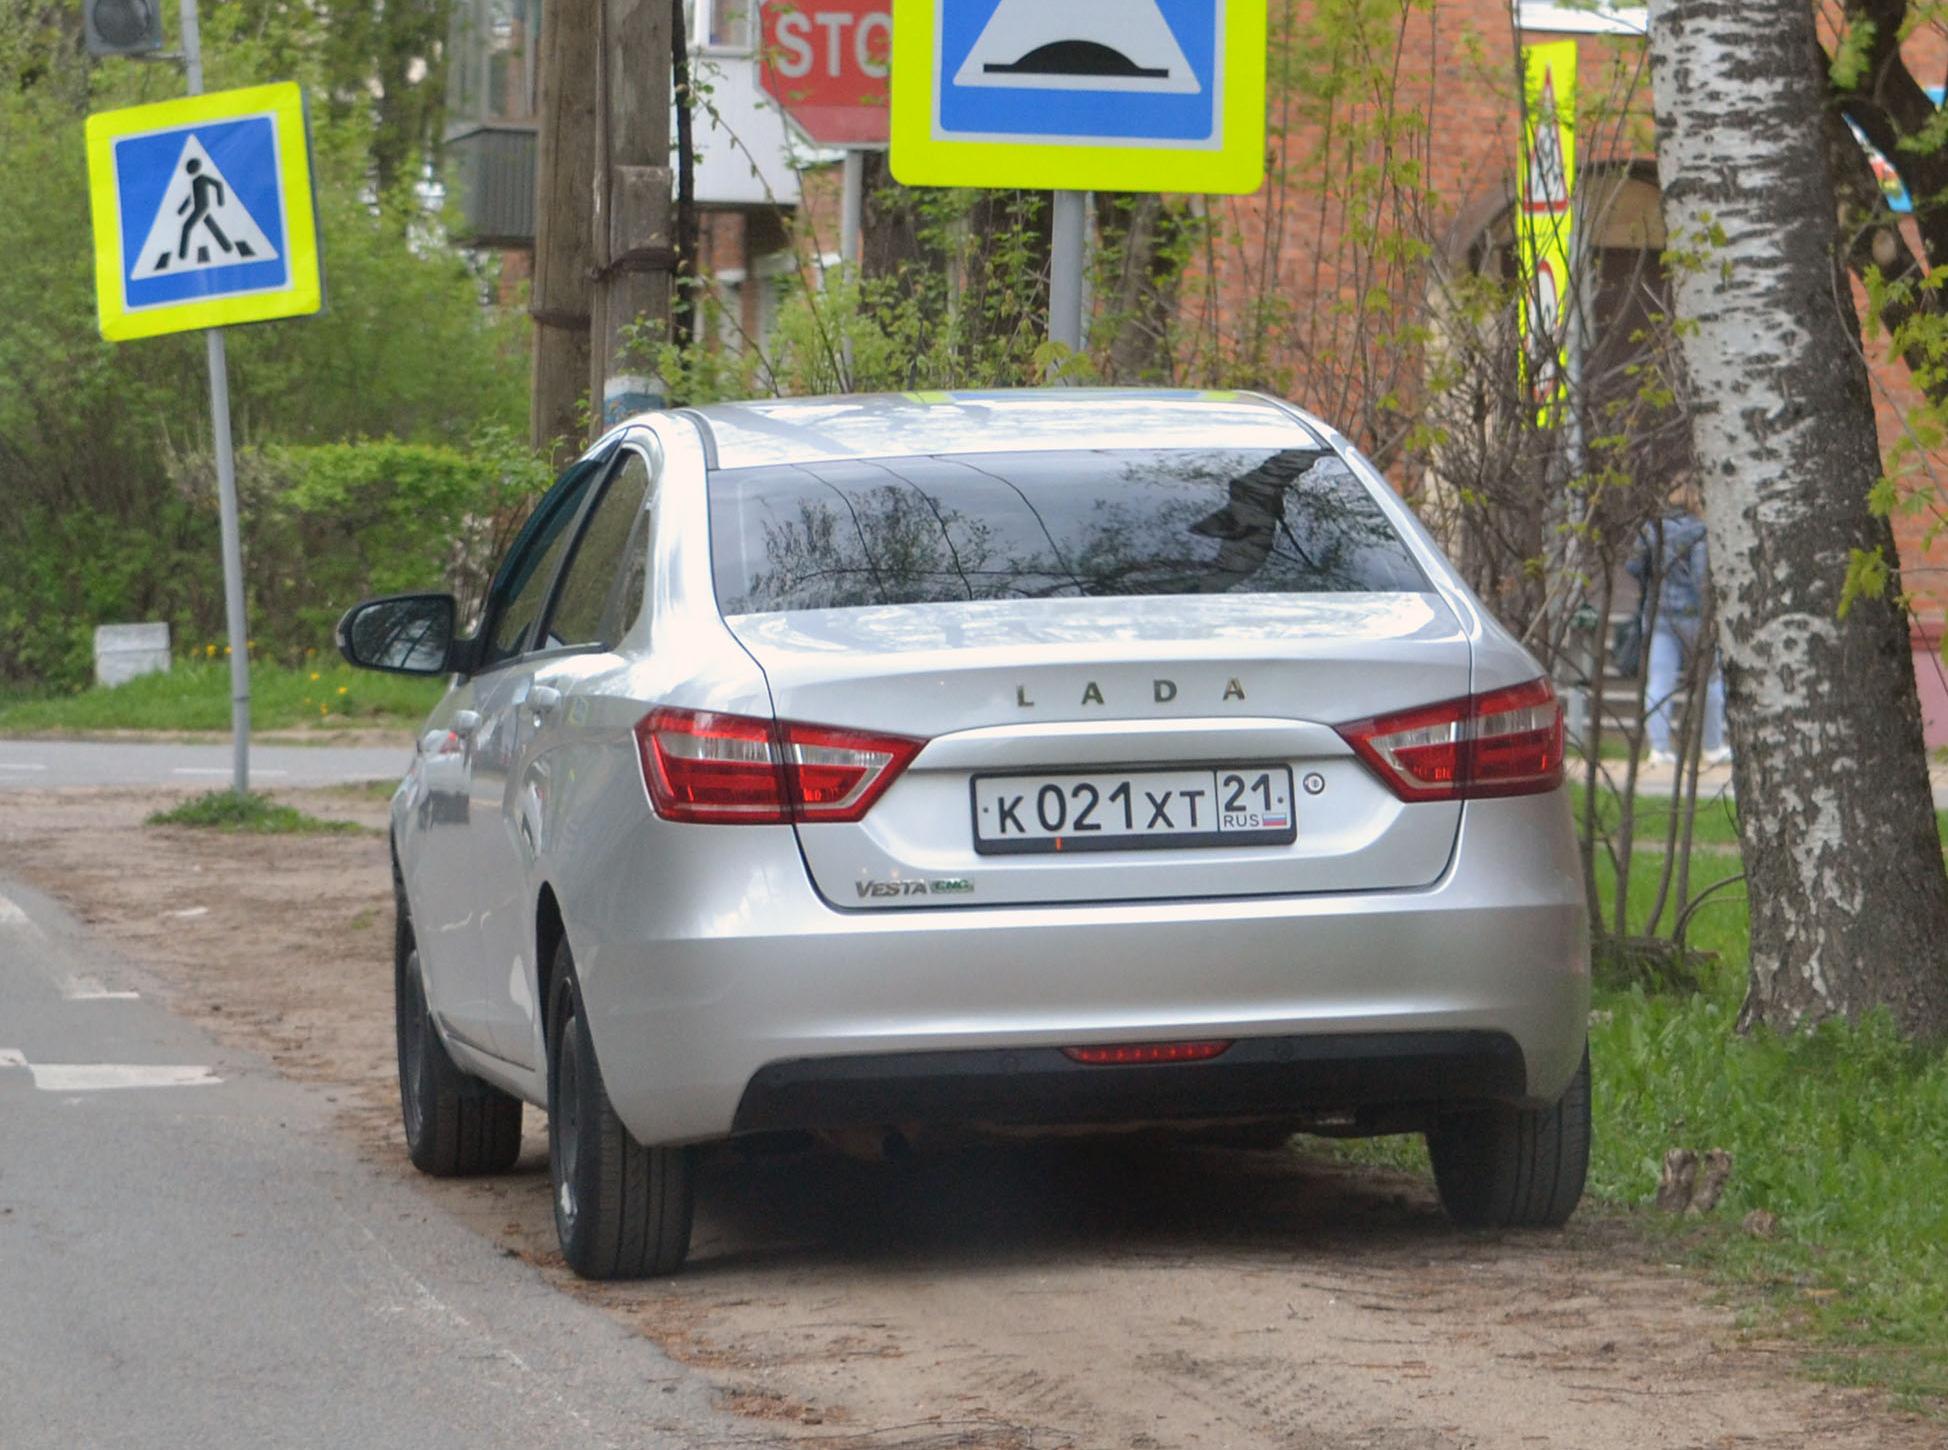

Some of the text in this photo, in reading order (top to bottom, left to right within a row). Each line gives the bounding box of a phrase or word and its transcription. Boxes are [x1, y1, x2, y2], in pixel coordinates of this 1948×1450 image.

[774, 12, 893, 77] STO
[1018, 679, 1245, 707] LADA
[1222, 774, 1269, 812] 21
[1222, 813, 1259, 828] RUS
[855, 879, 928, 898] VESTA
